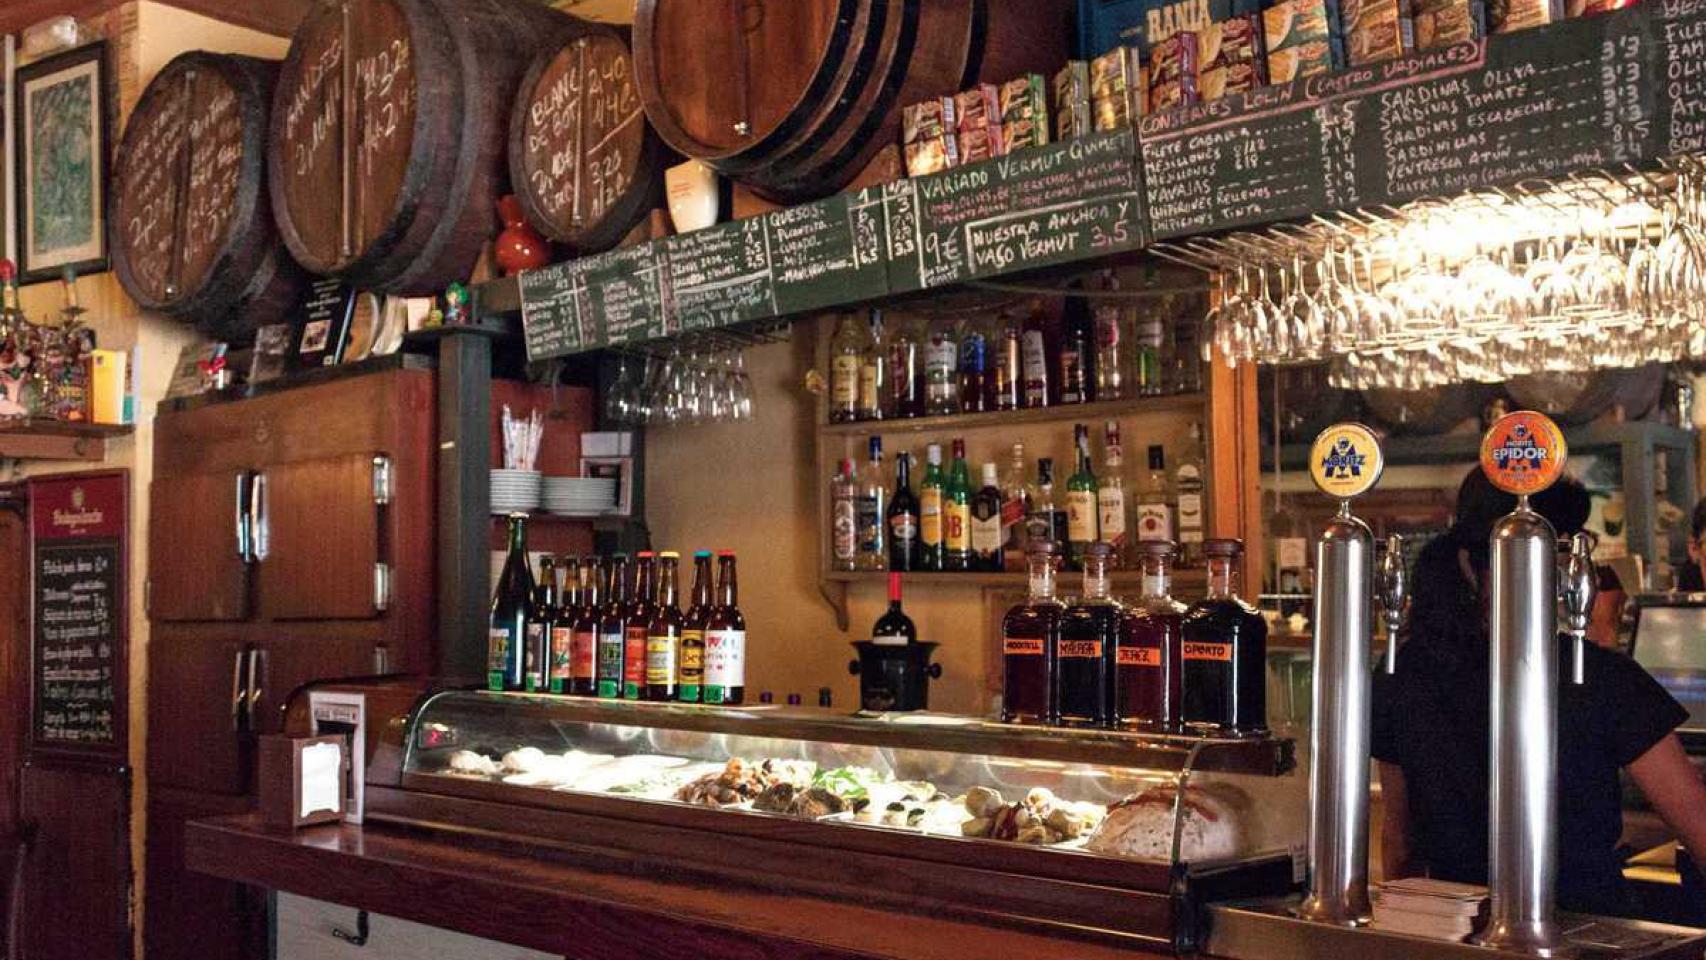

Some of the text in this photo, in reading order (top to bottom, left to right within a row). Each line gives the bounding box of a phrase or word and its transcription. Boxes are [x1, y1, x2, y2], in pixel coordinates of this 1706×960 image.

[1380, 77, 1471, 114] SARDINAS
[920, 170, 988, 200] VARIADO
[997, 150, 1066, 180] VERMUT
[973, 219, 1040, 246] NUESTRA
[1021, 231, 1080, 260] VERMUT
[1492, 447, 1547, 460] EPIDOR
[1184, 642, 1226, 656] OPORTO
